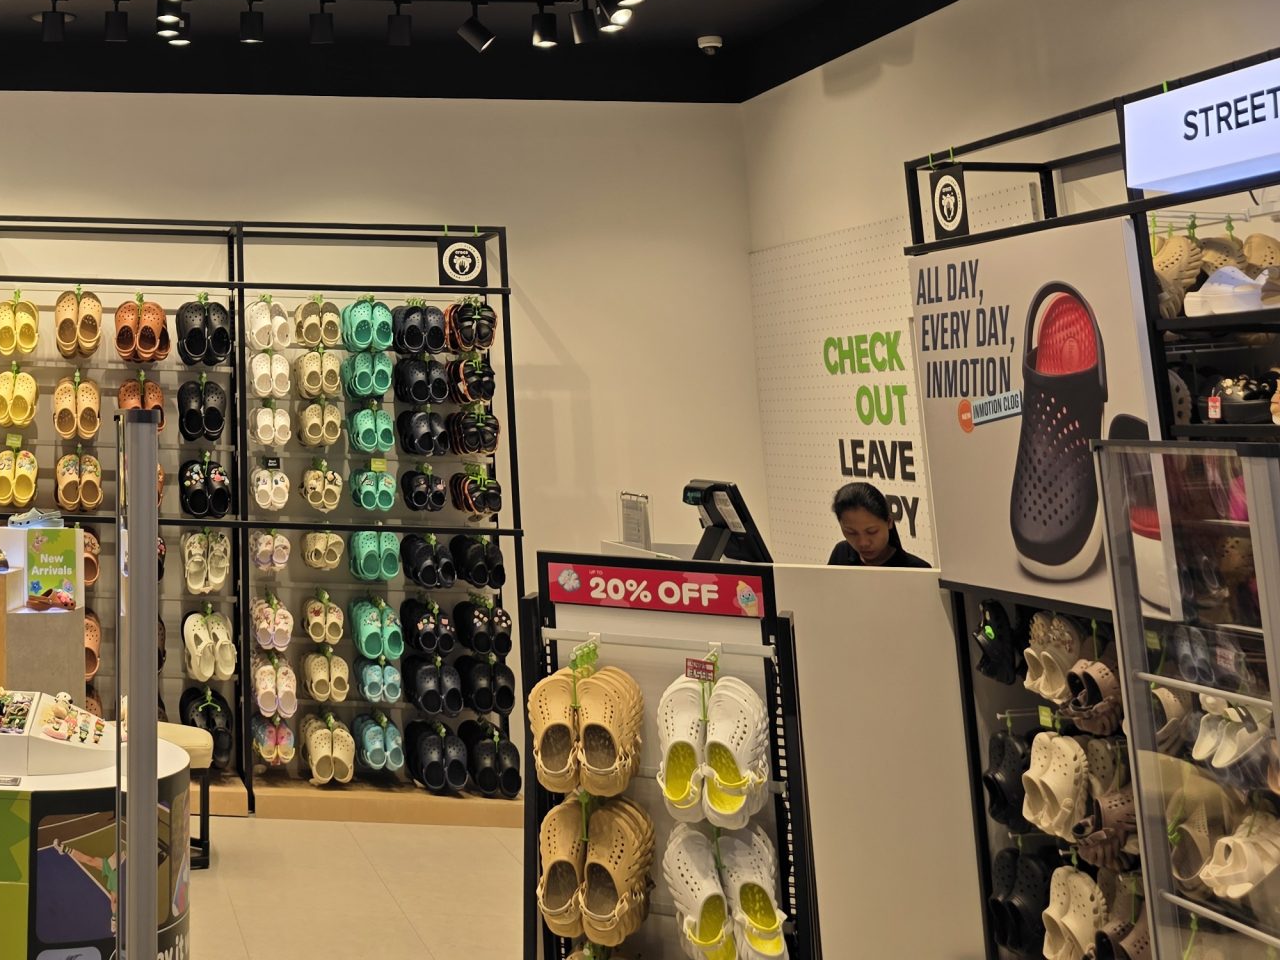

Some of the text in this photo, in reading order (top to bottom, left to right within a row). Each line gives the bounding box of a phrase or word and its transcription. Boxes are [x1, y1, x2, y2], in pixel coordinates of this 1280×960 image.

[1183, 85, 1280, 141] STREET
[916, 259, 983, 305] ALL DAY,
[922, 305, 1015, 352] EVERY DAY,
[824, 330, 905, 375] CHECK
[927, 356, 1011, 399] INMOTION
[855, 385, 907, 426] OUT
[973, 393, 1019, 419] INMOTION CLOG
[838, 438, 915, 481] LEAVE
[31, 565, 72, 575] Arrivals
[40, 553, 64, 563] New
[589, 576, 719, 607] 20% OFF
